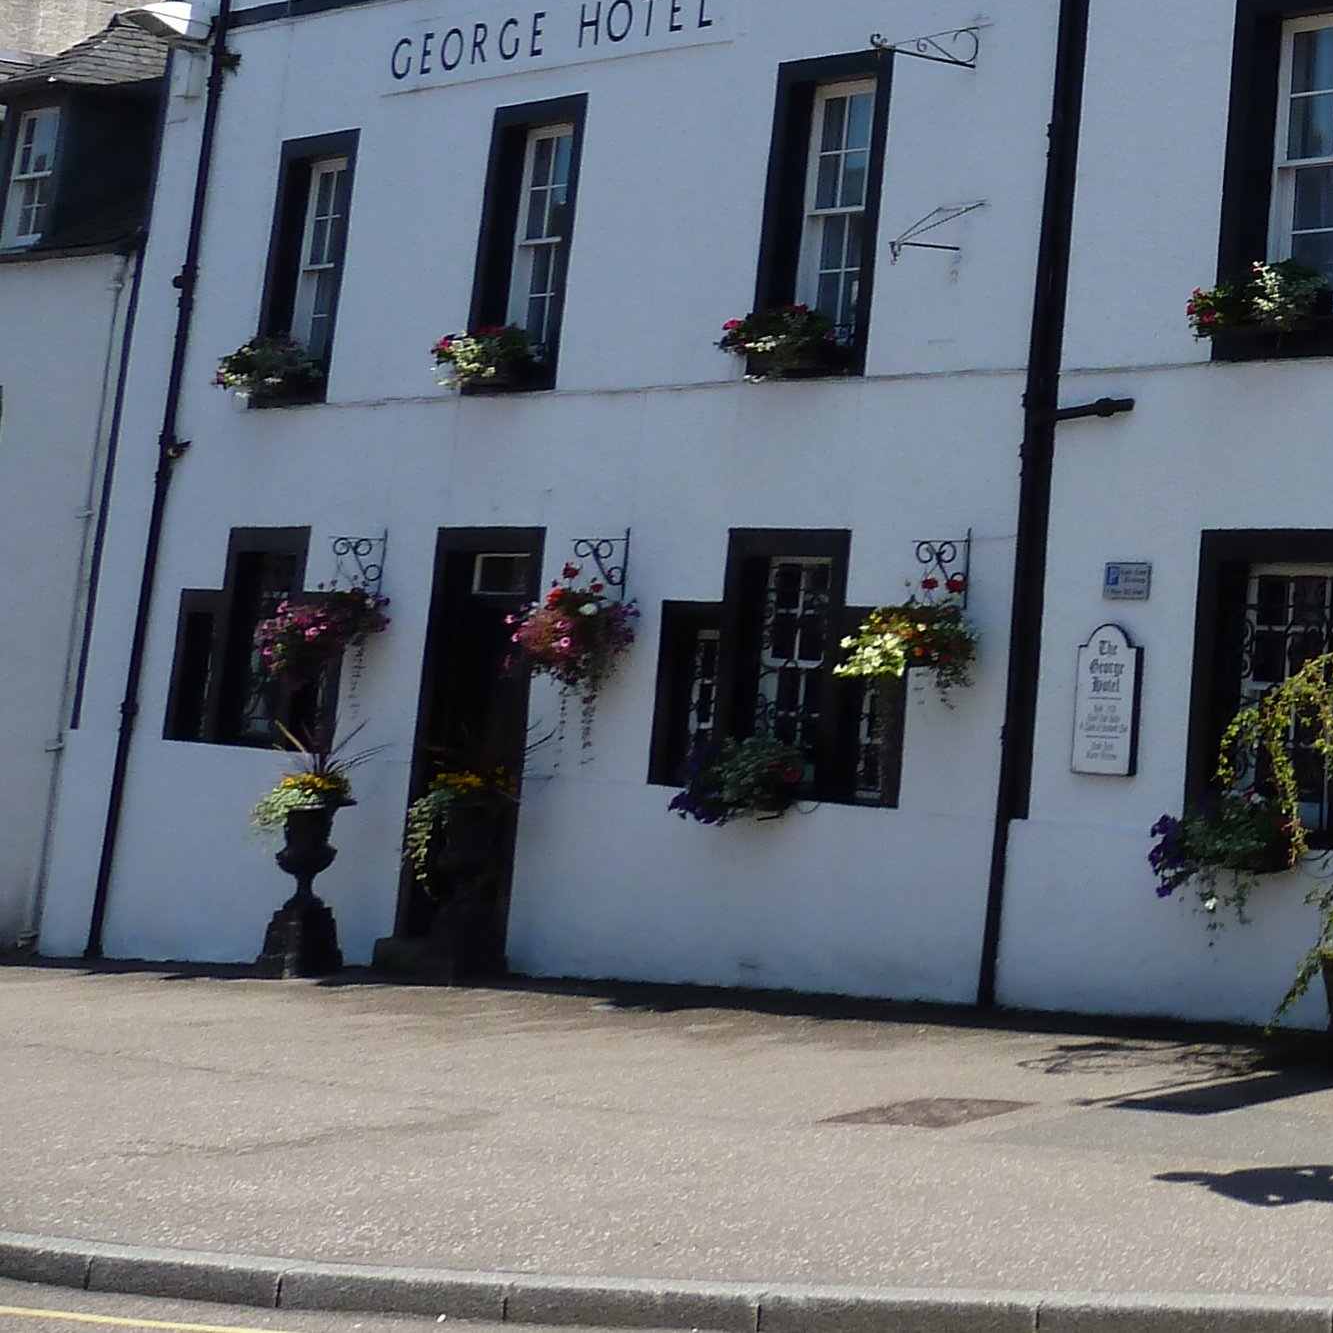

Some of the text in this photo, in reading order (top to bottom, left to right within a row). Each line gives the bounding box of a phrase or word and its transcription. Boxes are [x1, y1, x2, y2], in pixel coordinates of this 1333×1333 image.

[390, 11, 547, 81] GEORGE
[1098, 639, 1118, 657] The
[1089, 658, 1125, 678] George
[1092, 676, 1120, 693] Hotel
